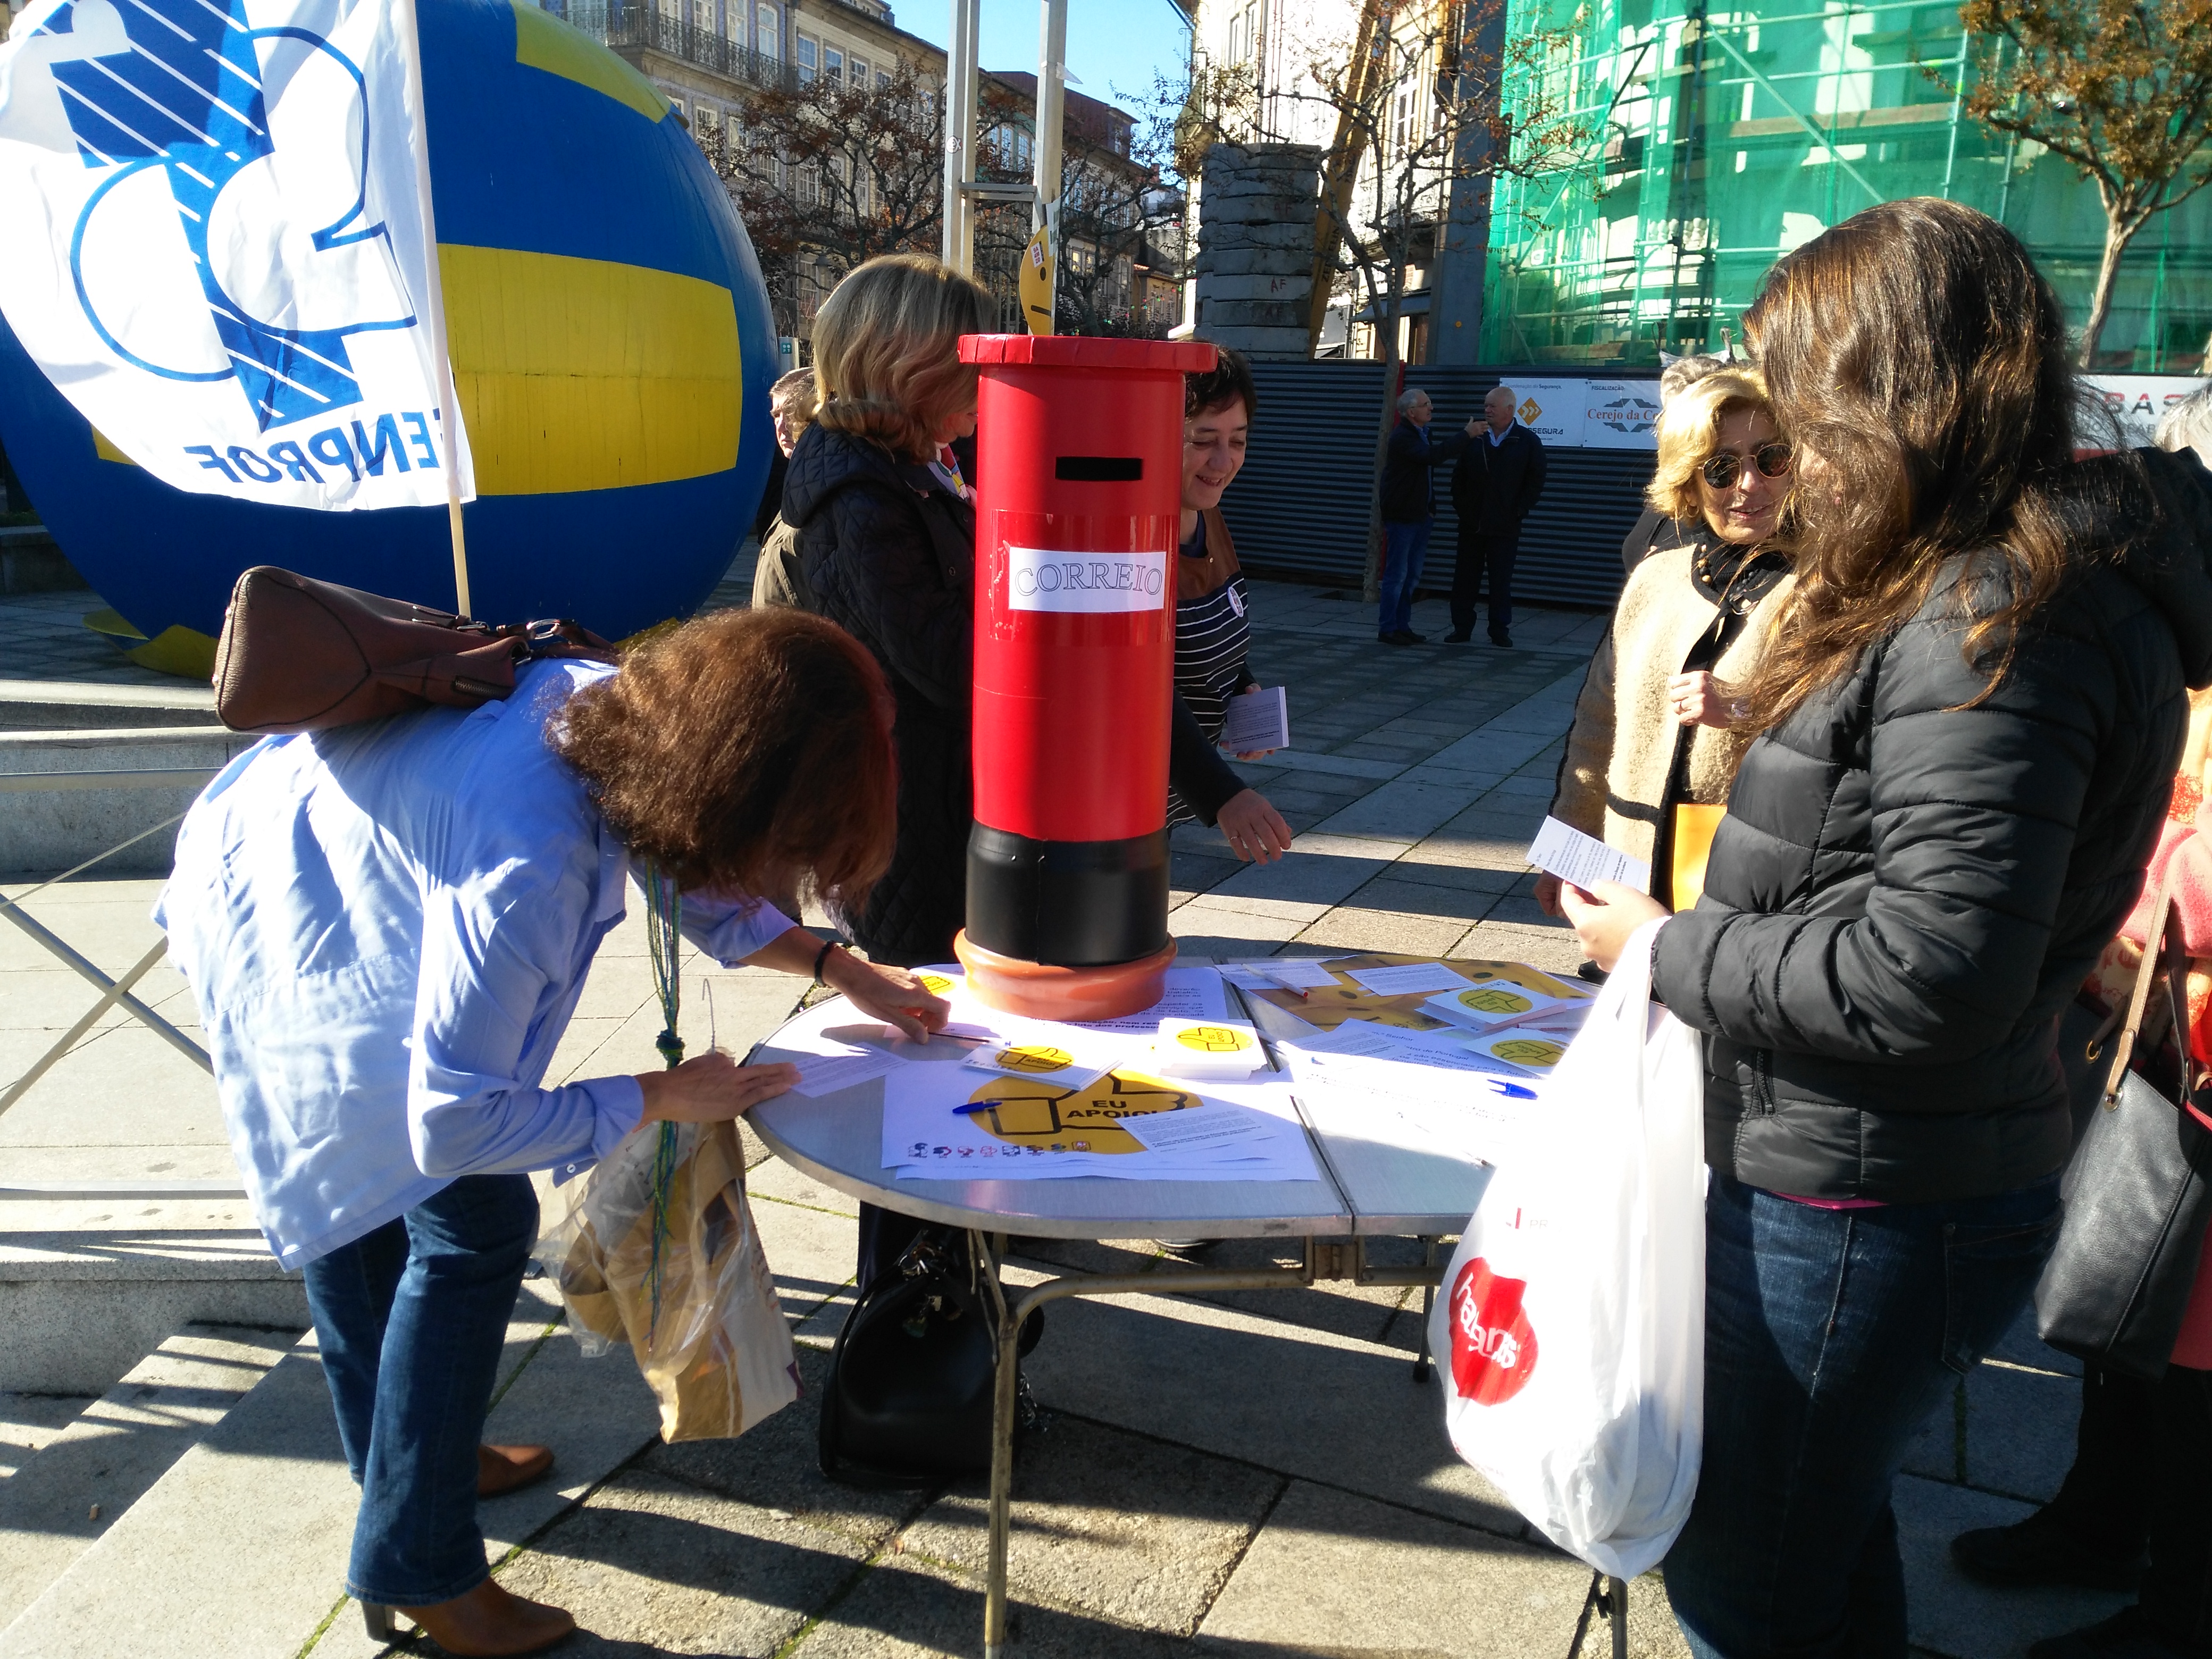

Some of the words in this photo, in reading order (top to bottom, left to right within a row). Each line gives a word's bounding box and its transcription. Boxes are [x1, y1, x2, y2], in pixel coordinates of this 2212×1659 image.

[1587, 408, 1623, 422] Cerejo
[1627, 410, 1639, 420] da
[1015, 563, 1162, 596] CORREIO
[1092, 1100, 1127, 1109] EU
